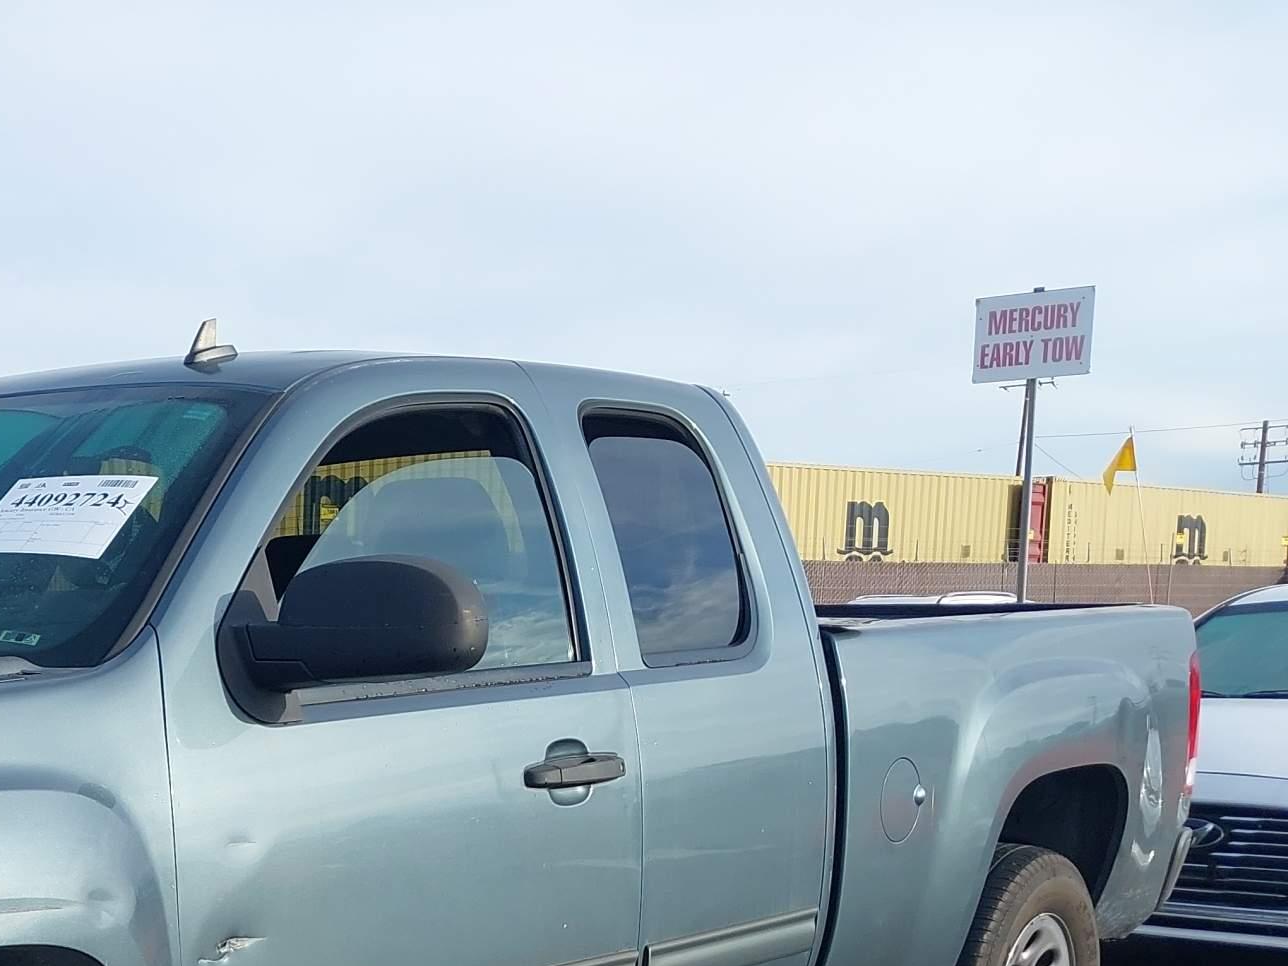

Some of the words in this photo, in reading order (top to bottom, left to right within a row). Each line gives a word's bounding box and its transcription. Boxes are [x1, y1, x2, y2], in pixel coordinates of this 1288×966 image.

[987, 301, 1082, 336] MERCURY
[980, 340, 1034, 369] EARLY
[1041, 335, 1086, 364] TOW
[11, 492, 124, 508] 44092724
